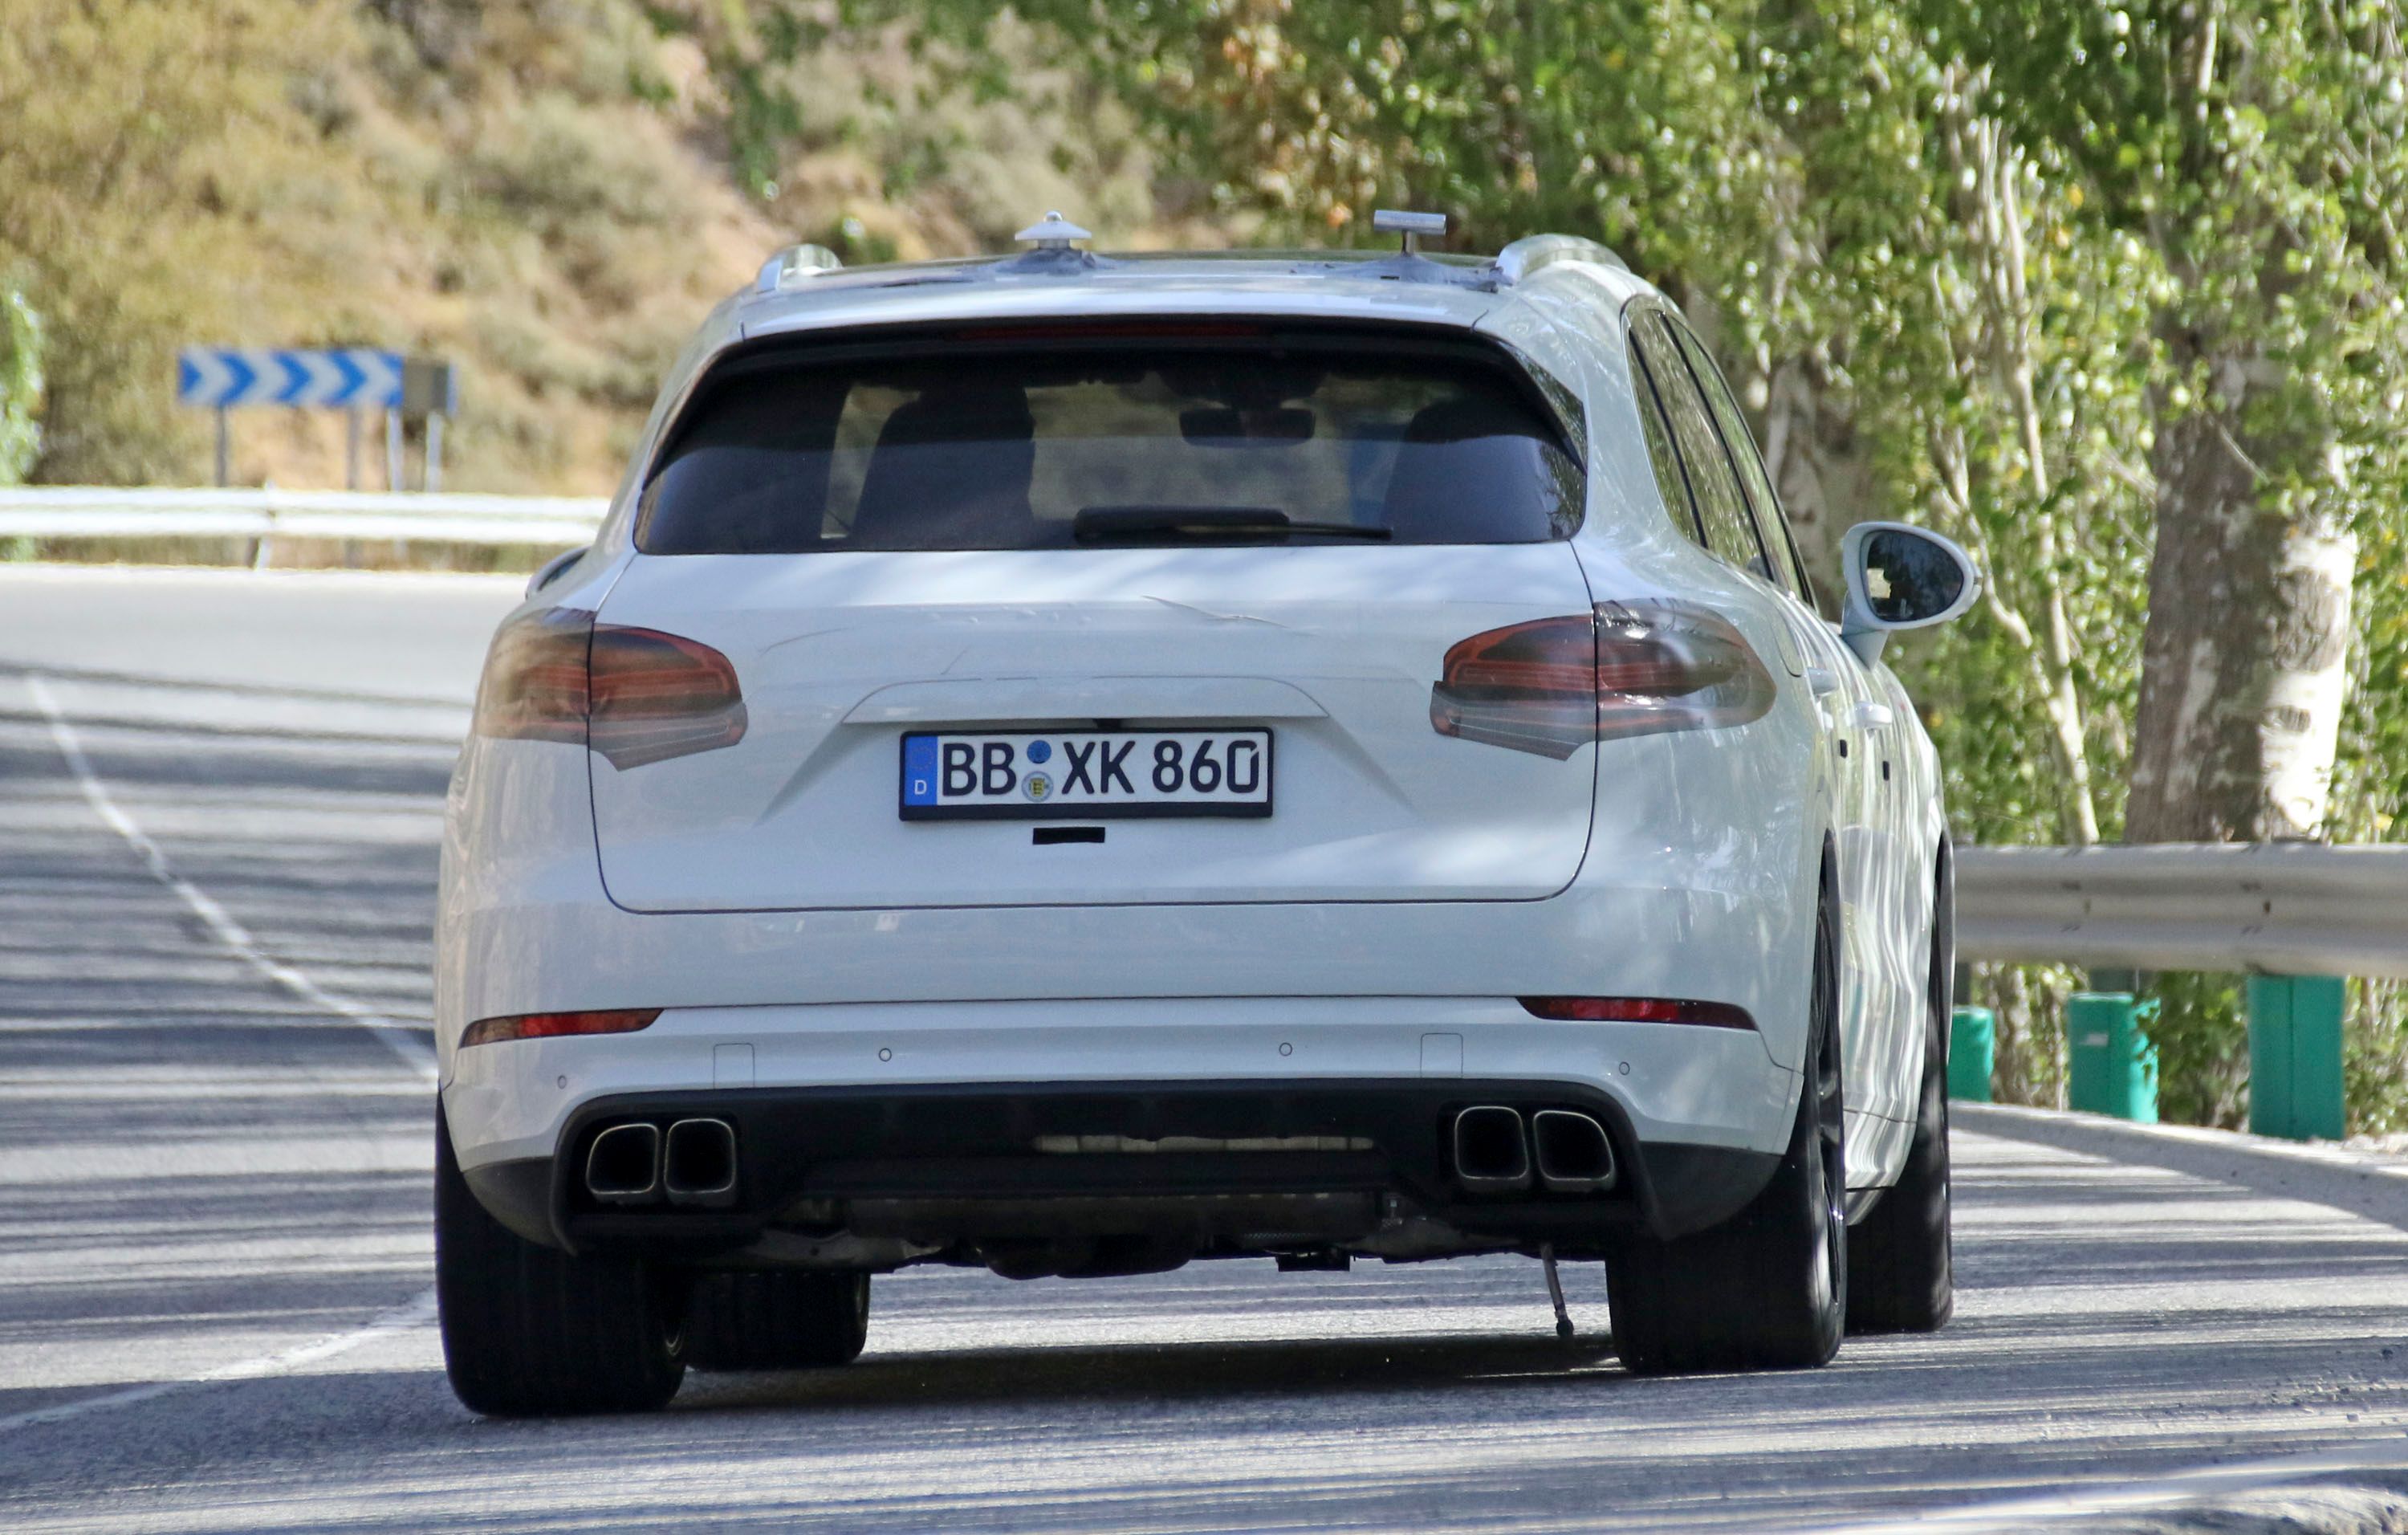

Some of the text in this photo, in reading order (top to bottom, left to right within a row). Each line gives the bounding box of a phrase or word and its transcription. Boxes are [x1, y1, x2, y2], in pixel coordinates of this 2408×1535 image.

[942, 739, 1259, 797] BB XK 860
[913, 780, 927, 795] D
